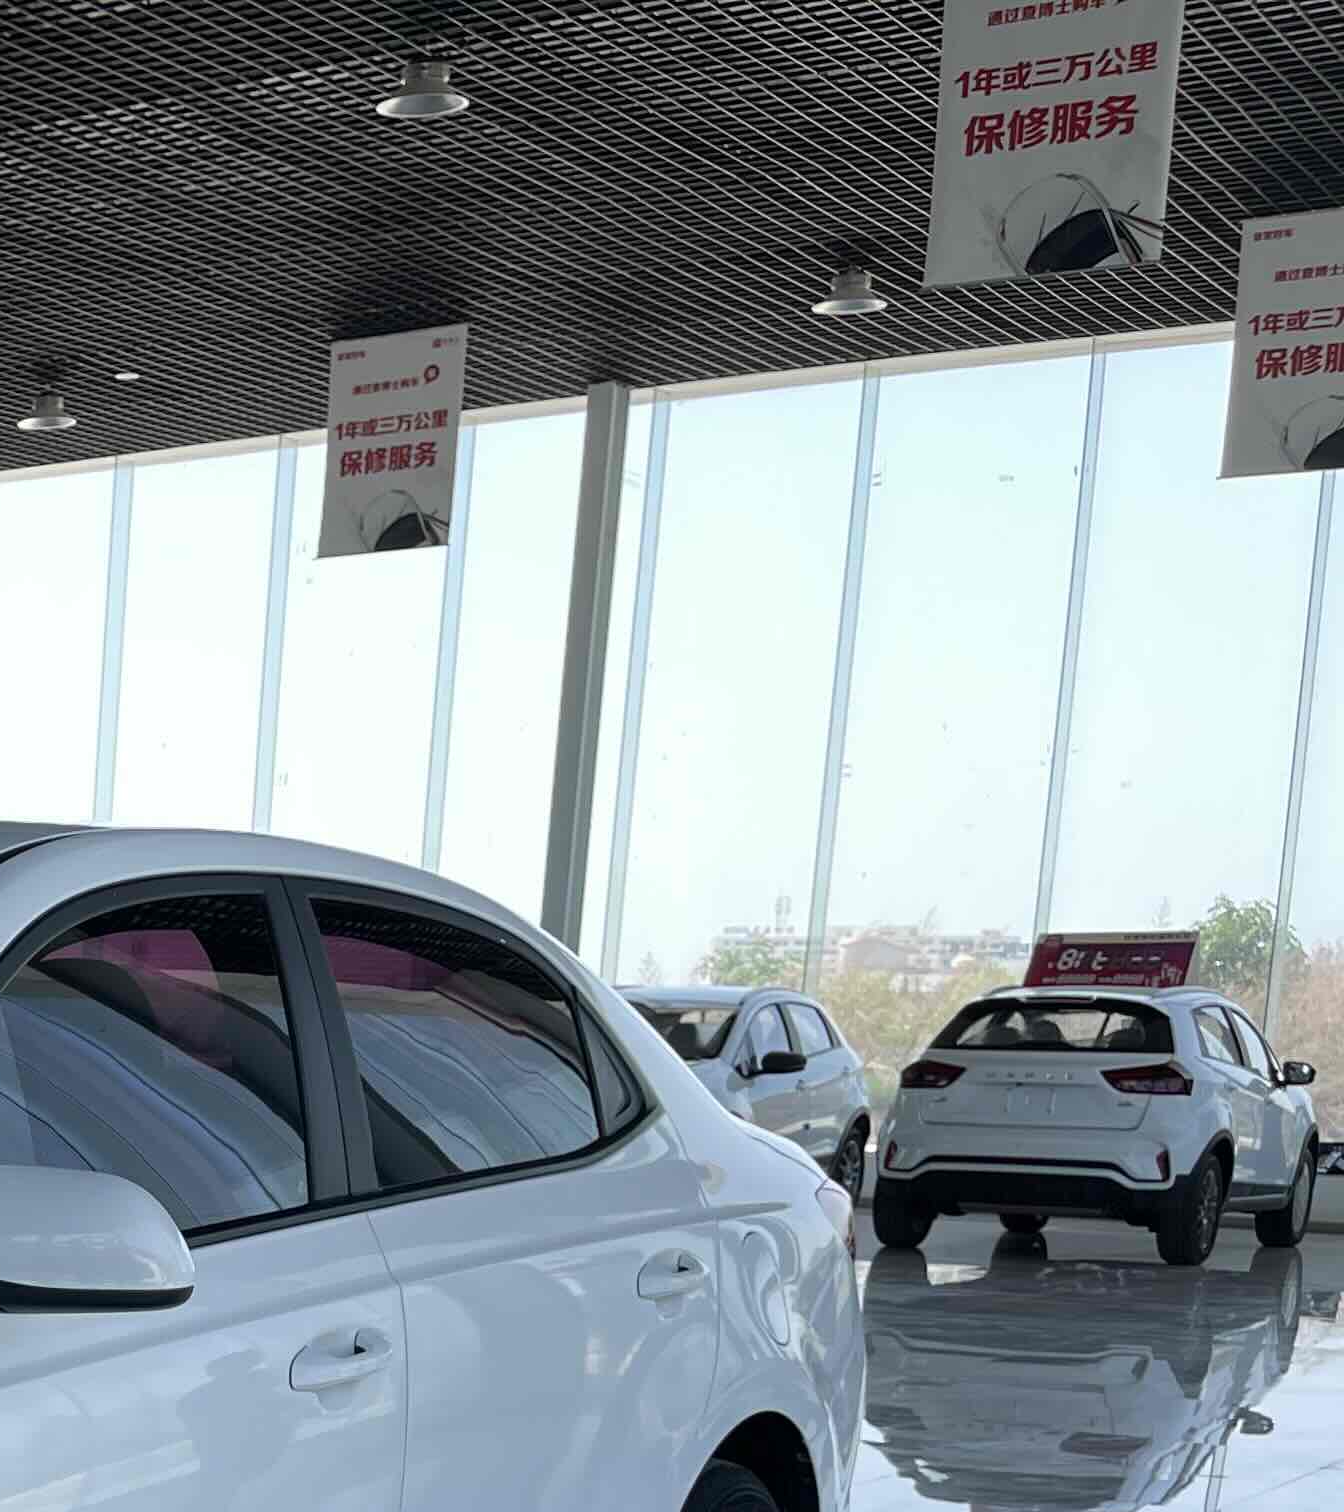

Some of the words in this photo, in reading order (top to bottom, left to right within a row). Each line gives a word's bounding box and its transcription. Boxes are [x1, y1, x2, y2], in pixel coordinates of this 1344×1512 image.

[954, 41, 1158, 98] 1年或三万公里
[964, 95, 1139, 157] 保修服务
[335, 409, 448, 440] 1年或三万公里
[339, 441, 438, 478] 保修服务
